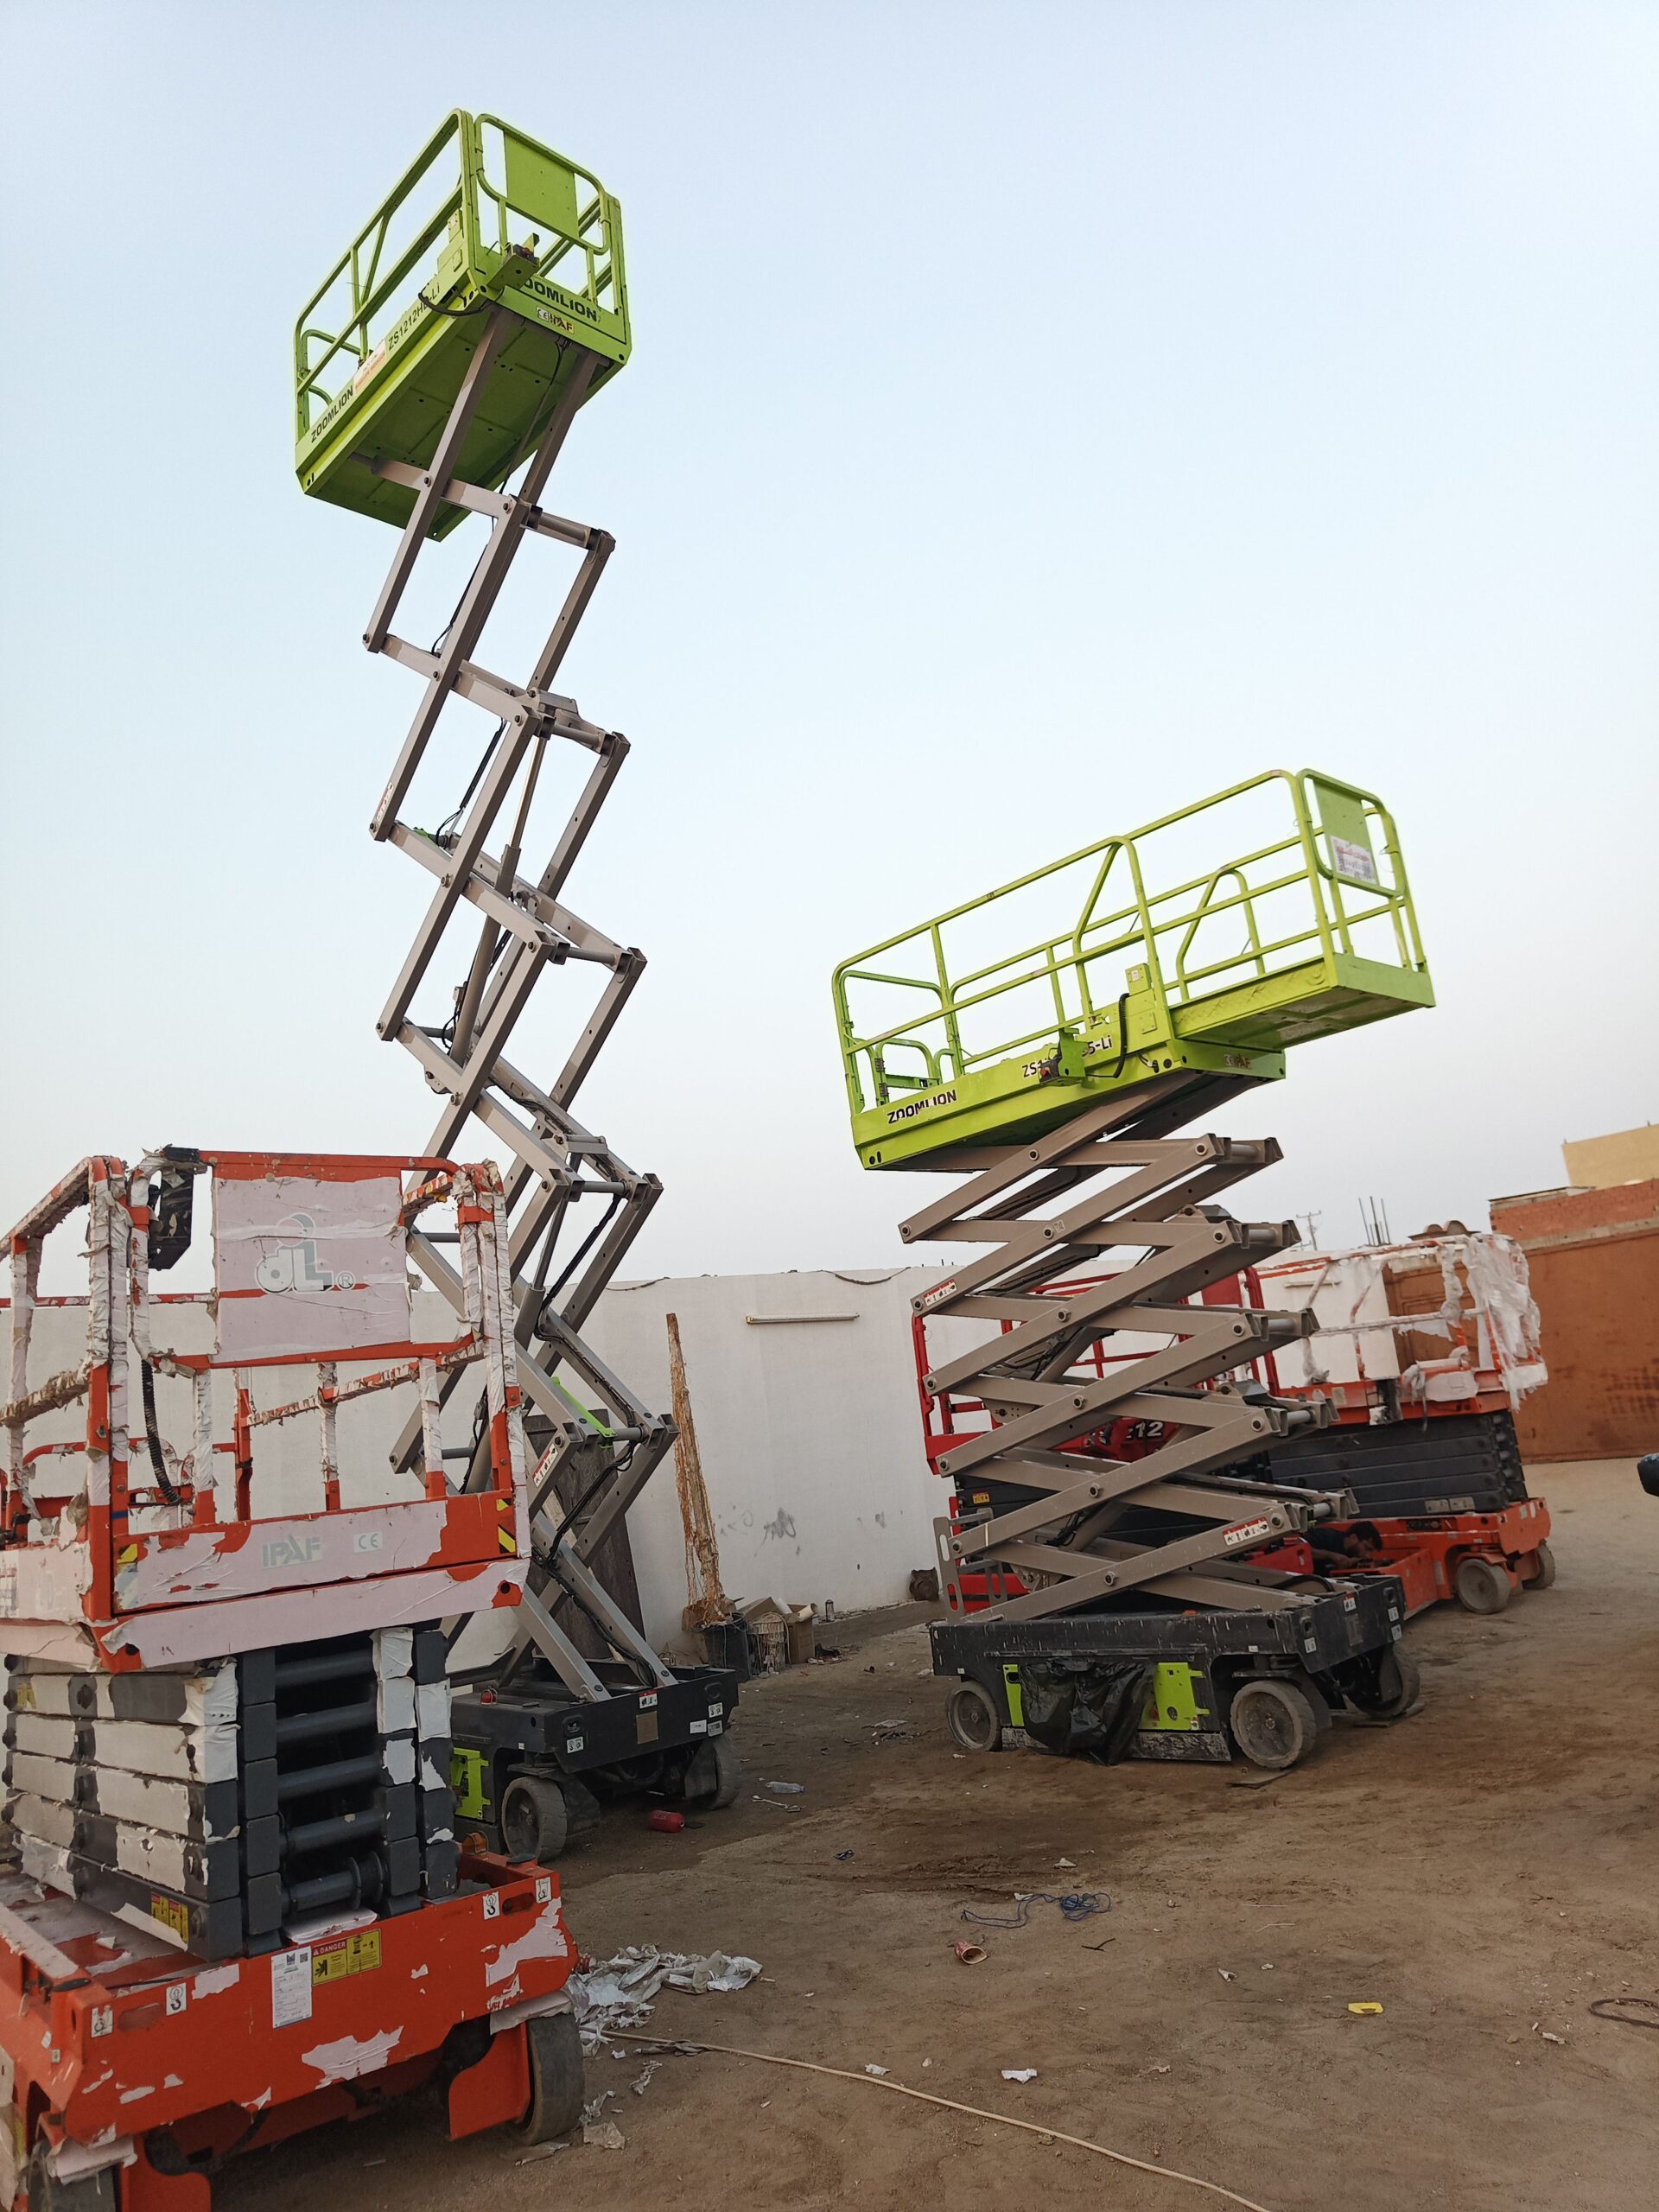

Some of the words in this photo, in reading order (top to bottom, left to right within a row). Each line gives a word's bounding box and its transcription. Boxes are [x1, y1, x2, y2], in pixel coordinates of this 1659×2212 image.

[524, 278, 597, 321] OOMLION
[311, 385, 353, 443] ZOOMLION
[262, 1533, 321, 1567] IPAF
[358, 1533, 379, 1549] CE
[320, 1941, 346, 1955] DANGER
